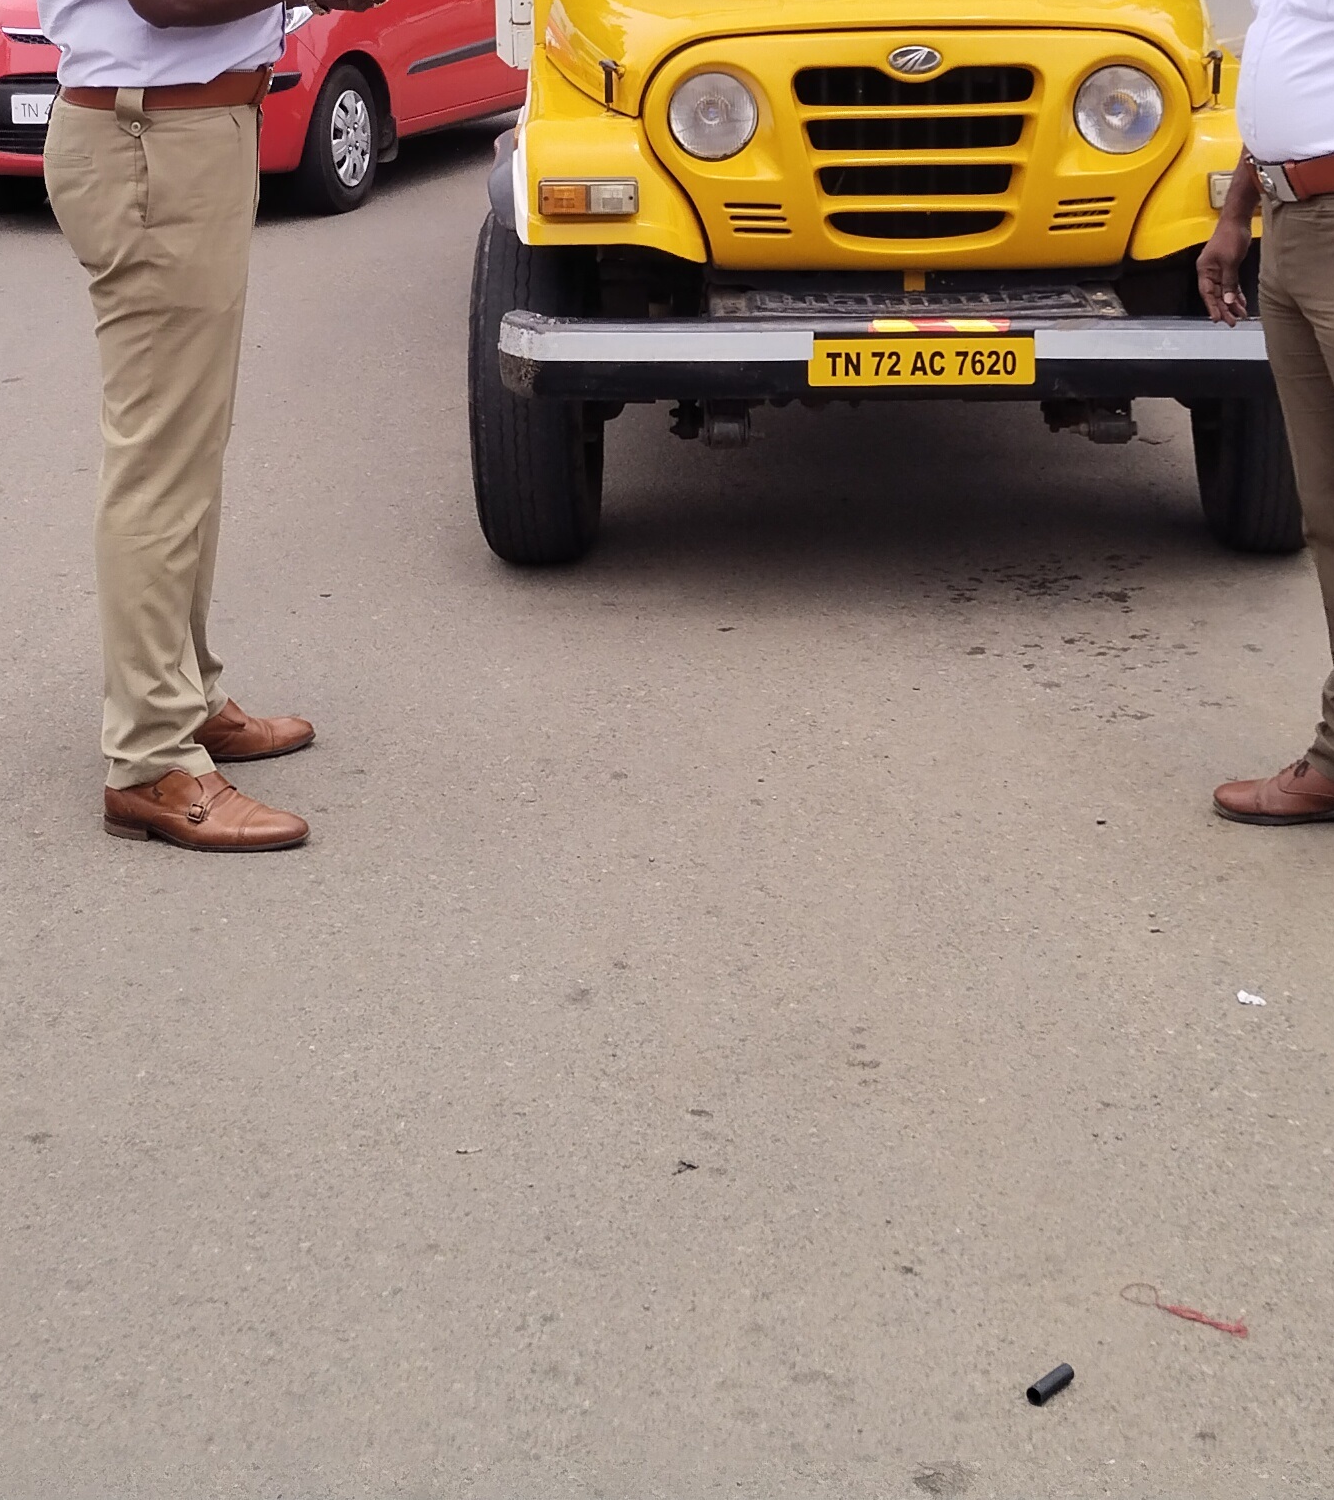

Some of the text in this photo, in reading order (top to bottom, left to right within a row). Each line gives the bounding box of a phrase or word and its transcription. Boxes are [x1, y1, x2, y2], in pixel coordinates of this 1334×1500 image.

[21, 103, 39, 118] TN
[826, 350, 1017, 377] TN 72 AC 7620
